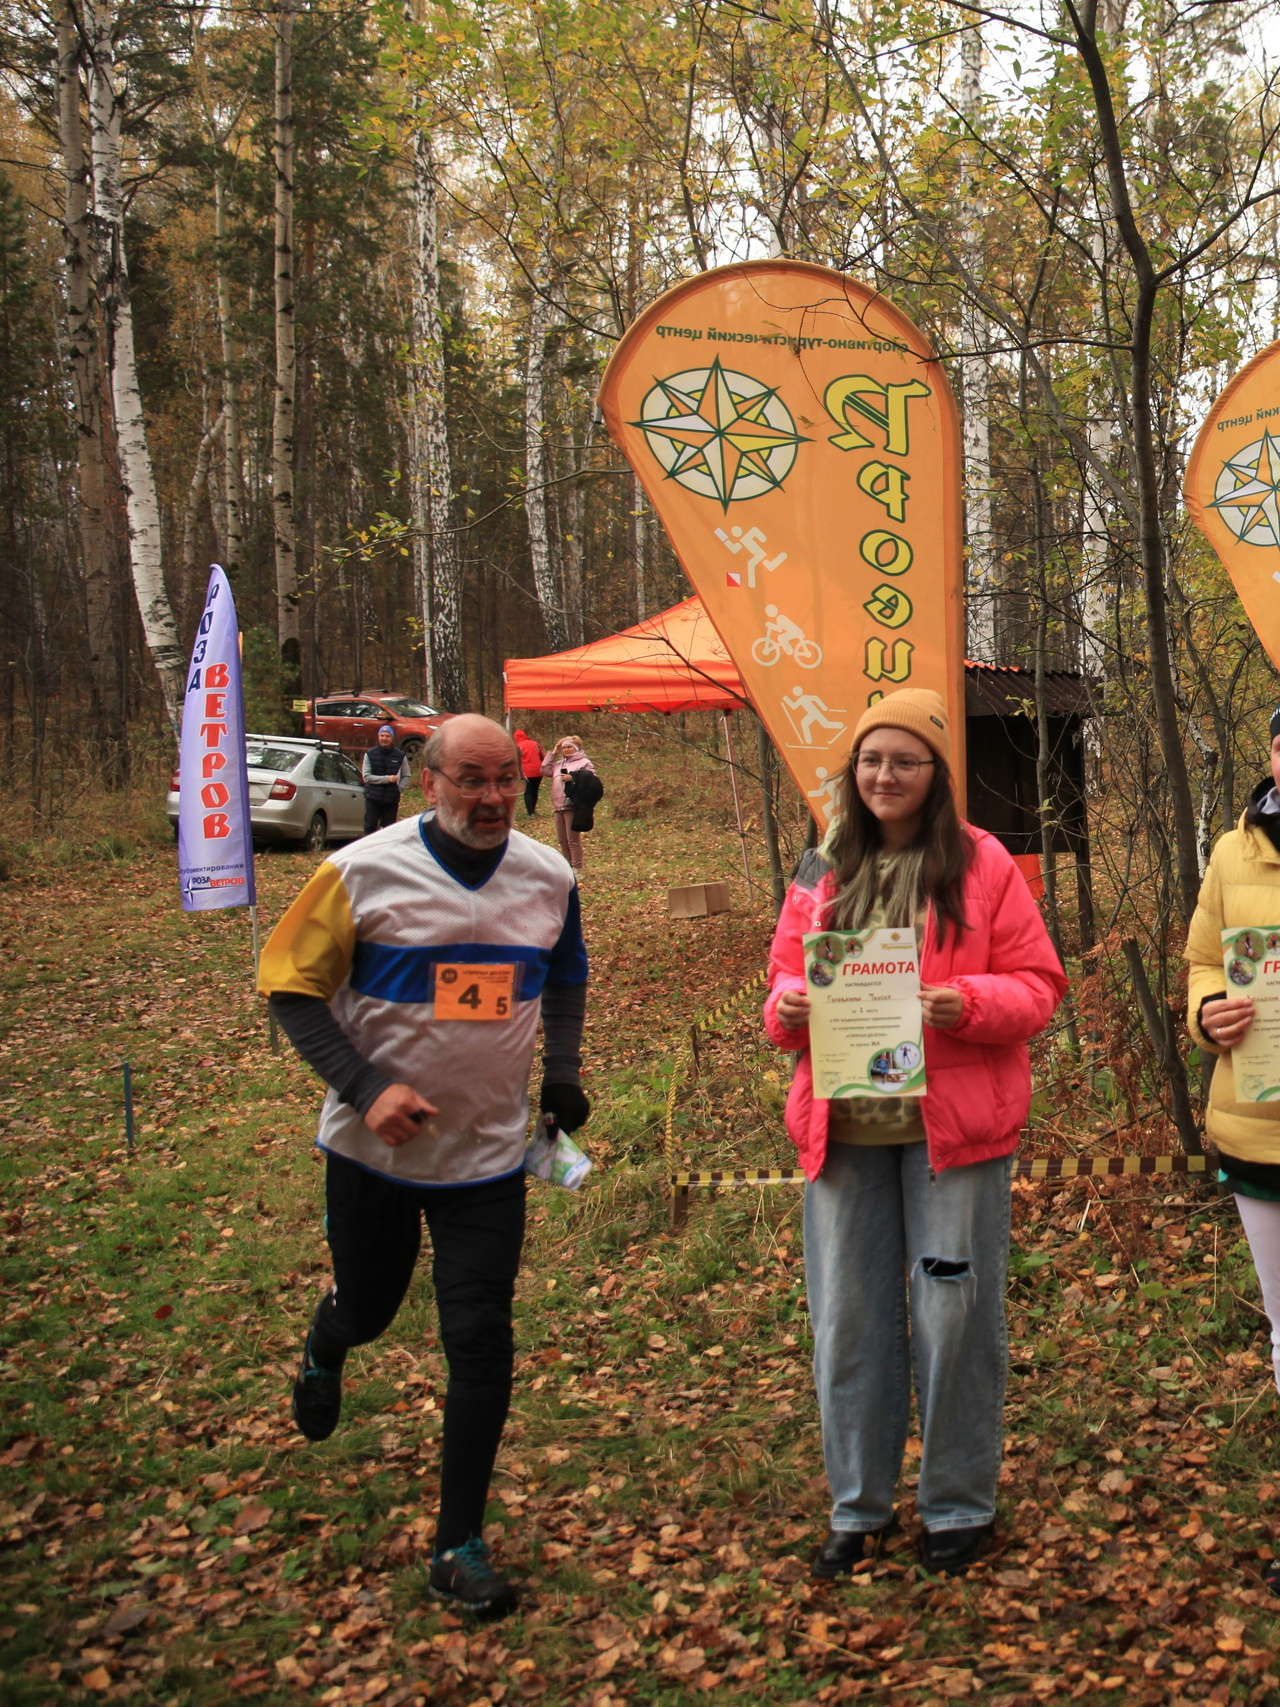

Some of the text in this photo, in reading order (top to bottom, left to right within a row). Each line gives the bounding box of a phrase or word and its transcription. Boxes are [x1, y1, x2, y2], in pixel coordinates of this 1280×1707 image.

[187, 583, 220, 693] РОЗА
[200, 662, 232, 840] ВЕТРОВ
[192, 876, 245, 888] РОЗА ВЕТРОВ
[842, 961, 916, 977] ГРАМОТА
[457, 983, 482, 1010] 4
[495, 996, 508, 1016] 5
